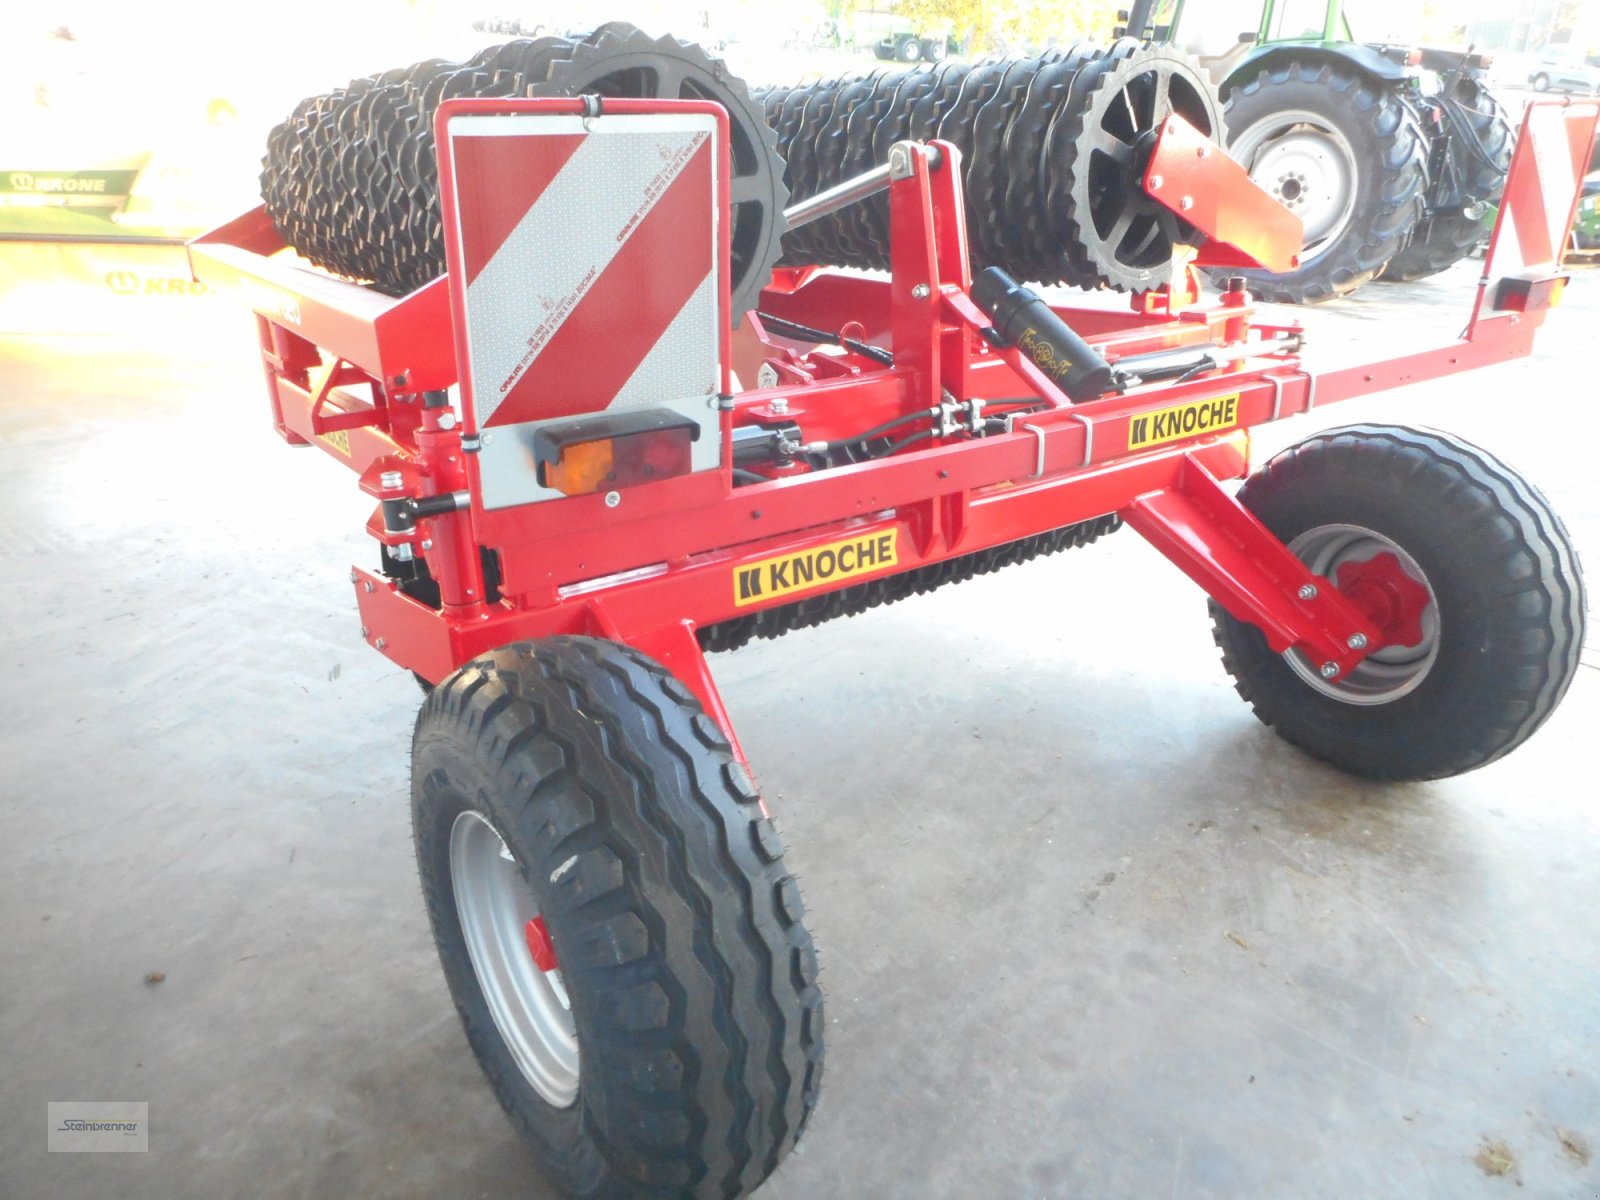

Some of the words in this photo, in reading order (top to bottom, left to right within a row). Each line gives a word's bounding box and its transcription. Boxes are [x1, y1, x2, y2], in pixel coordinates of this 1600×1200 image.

[34, 178, 106, 192] KRONE
[1151, 397, 1236, 440] KNOCHE
[770, 534, 893, 592] KNOCHE
